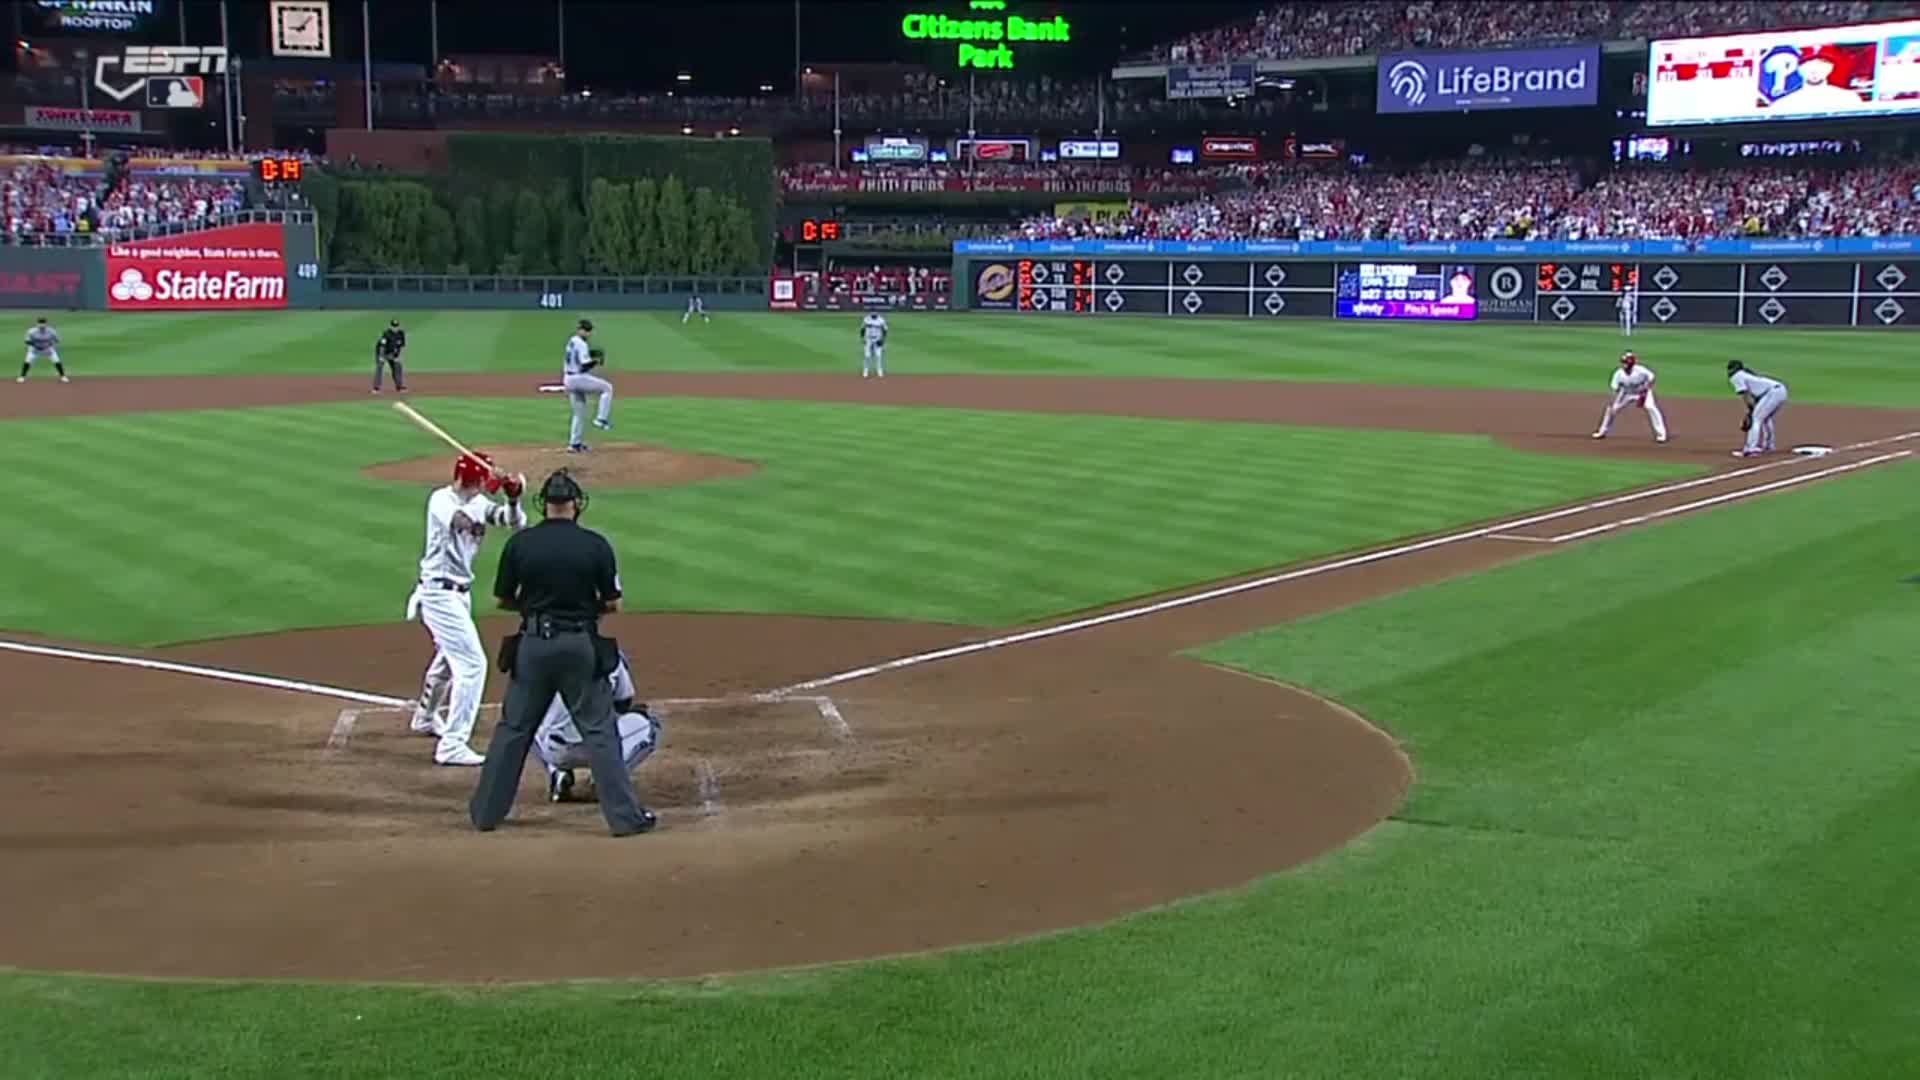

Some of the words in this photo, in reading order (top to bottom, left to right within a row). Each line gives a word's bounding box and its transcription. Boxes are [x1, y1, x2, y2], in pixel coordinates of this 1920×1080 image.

[61, 16, 133, 29] ROOFTOP
[902, 14, 1003, 39] Citizens
[1007, 16, 1070, 41] Bank
[959, 43, 1014, 68] Park
[1437, 60, 1586, 95] LifeBrand
[111, 246, 130, 257] Like
[204, 249, 225, 259] State
[227, 249, 248, 259] Farm
[1502, 276, 1512, 289] R
[540, 293, 562, 307] 401
